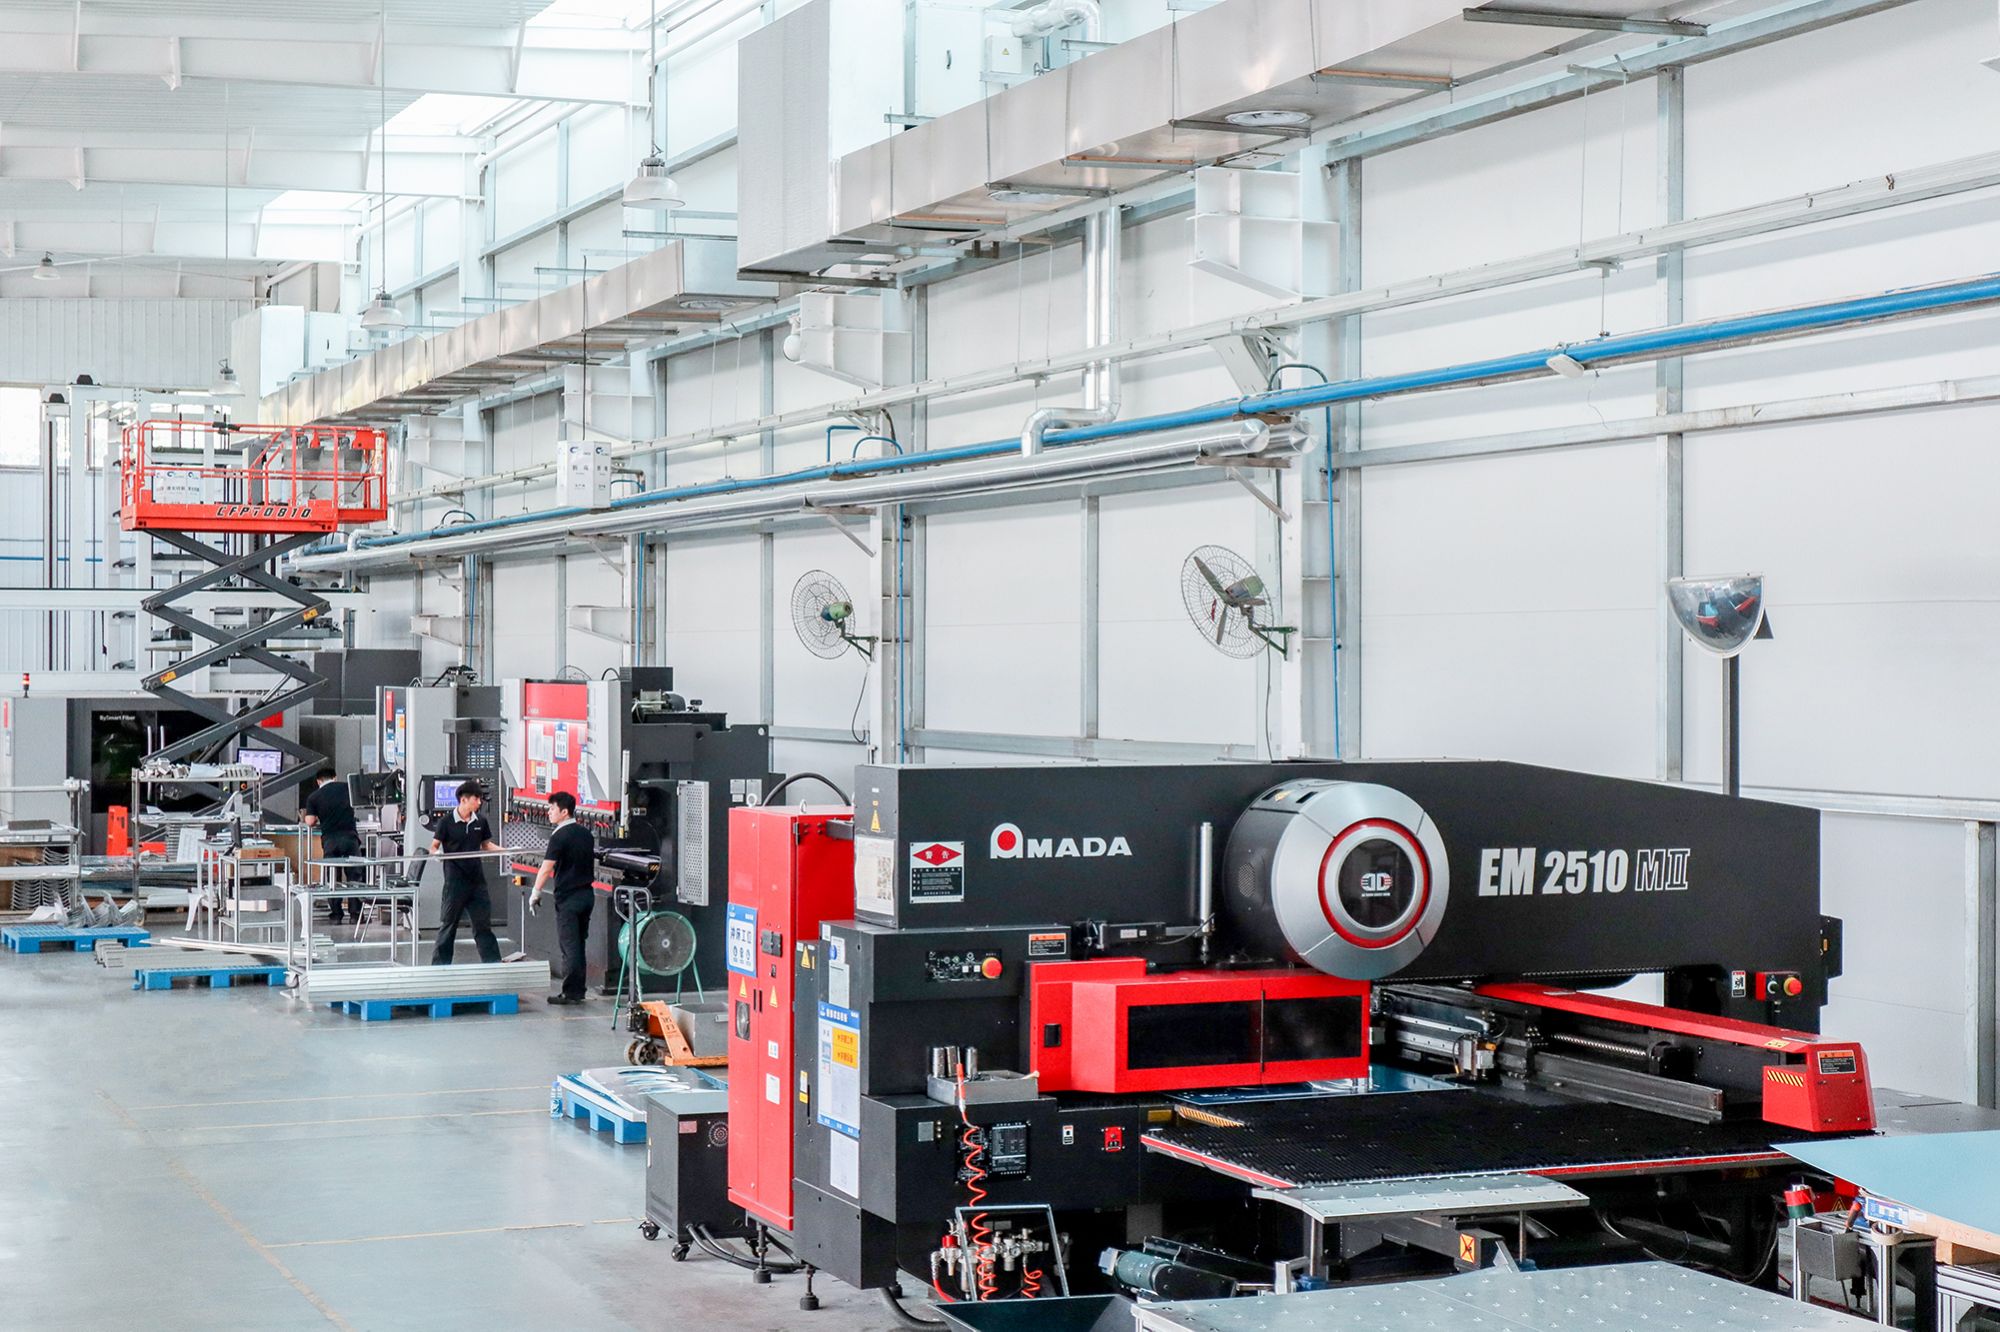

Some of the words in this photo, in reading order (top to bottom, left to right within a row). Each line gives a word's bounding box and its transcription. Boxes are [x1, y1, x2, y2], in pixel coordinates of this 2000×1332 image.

[990, 822, 1133, 860] AMADA
[1478, 847, 1537, 897] EM
[1541, 849, 1629, 895] 2510
